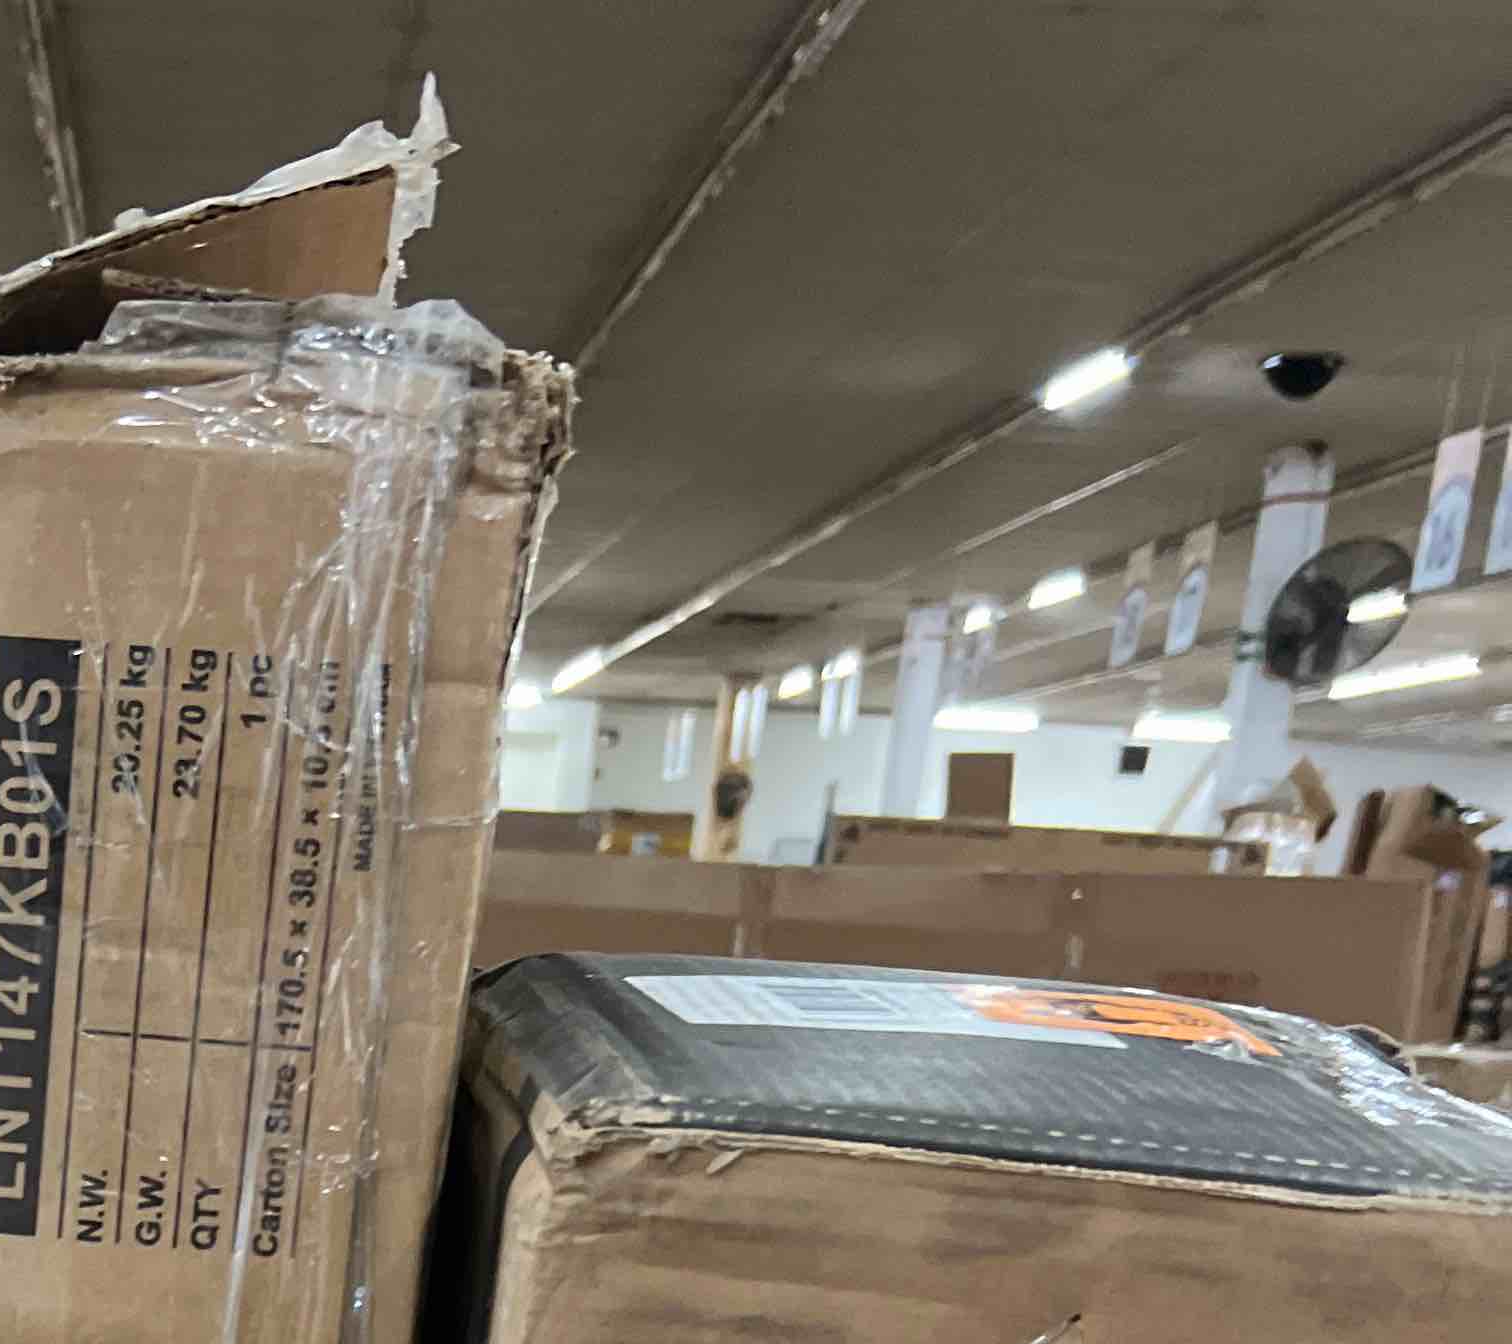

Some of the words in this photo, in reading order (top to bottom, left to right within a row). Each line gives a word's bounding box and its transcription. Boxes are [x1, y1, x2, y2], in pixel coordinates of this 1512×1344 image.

[182, 649, 217, 693] kg
[249, 654, 277, 698] pc
[172, 704, 207, 799] 23.70
[241, 712, 267, 729] 1
[289, 837, 321, 908] 38.5
[77, 1169, 108, 1243] N.W.
[120, 644, 154, 689] kg
[276, 948, 310, 1037] 170.5
[266, 1065, 297, 1134] Size
[136, 1170, 168, 1246] G.W.
[191, 1178, 222, 1250] QTY
[252, 1147, 286, 1257] Carton
